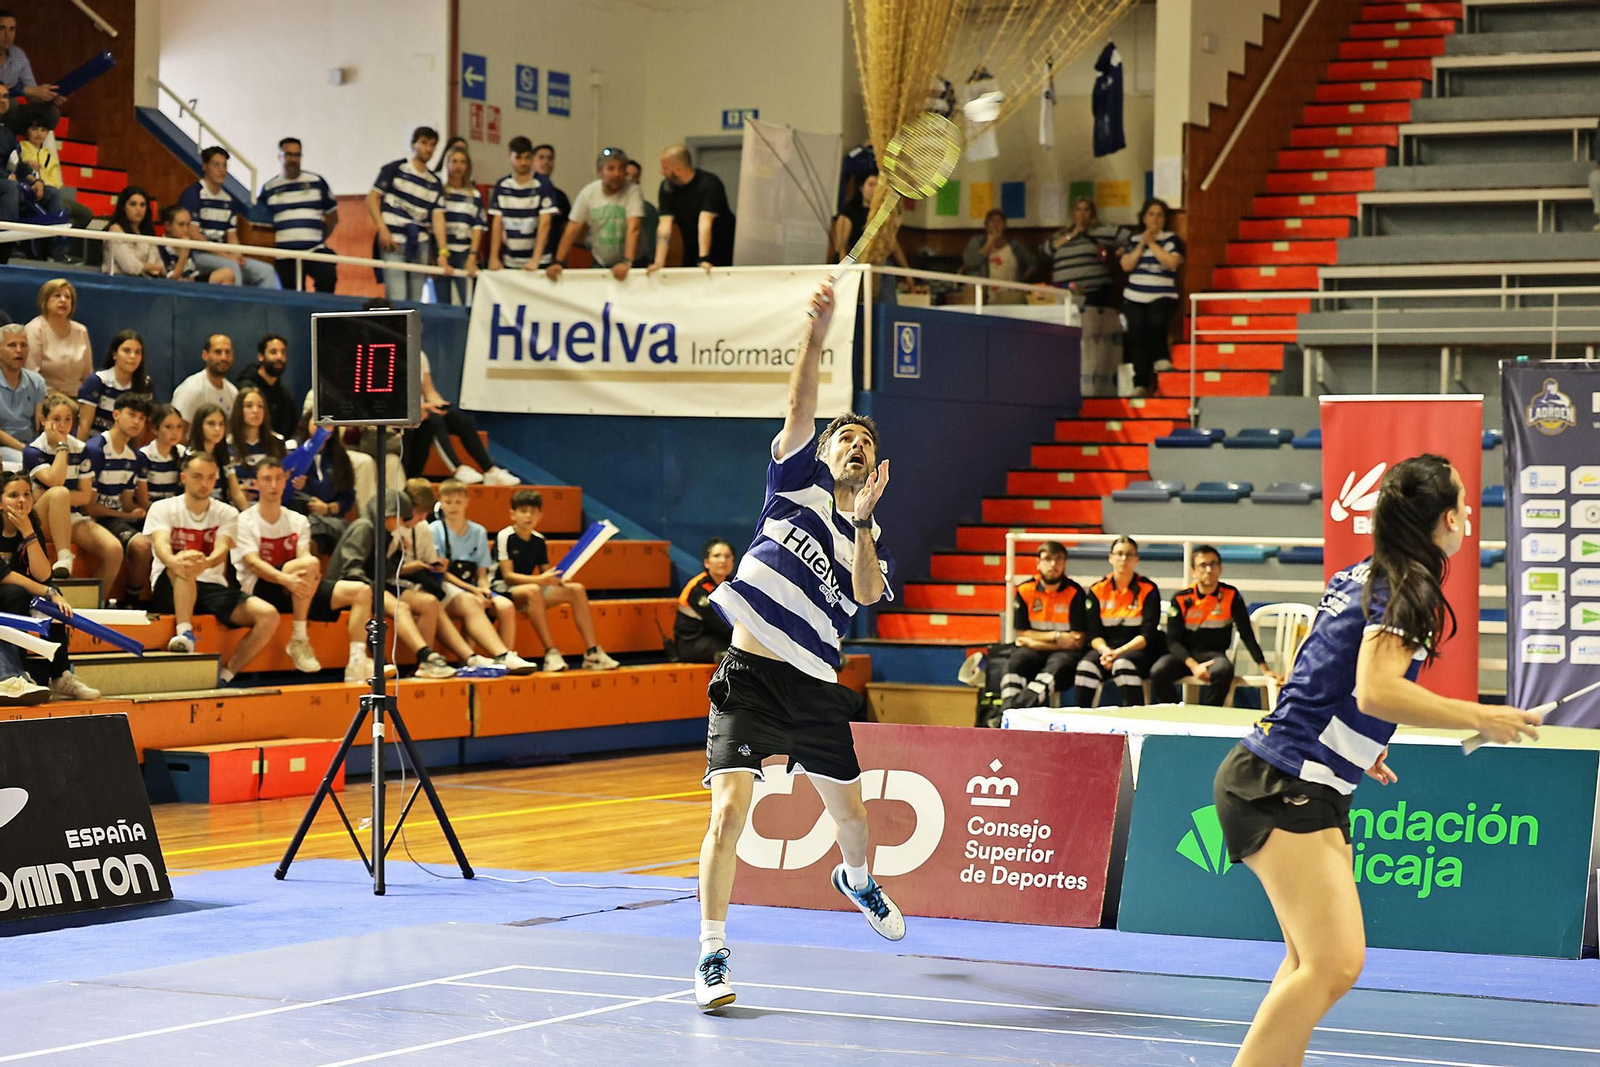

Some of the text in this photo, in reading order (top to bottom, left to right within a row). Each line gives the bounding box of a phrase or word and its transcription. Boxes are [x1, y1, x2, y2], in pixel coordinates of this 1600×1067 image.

[489, 302, 834, 366] Huelva Informacn
[354, 344, 396, 393] 10
[189, 702, 225, 724] F 7
[966, 815, 1052, 843] Consejo
[1348, 801, 1540, 846] ndación
[964, 840, 1055, 865] Superior
[1353, 842, 1464, 899] icaja
[960, 863, 1088, 891] de Deportes
